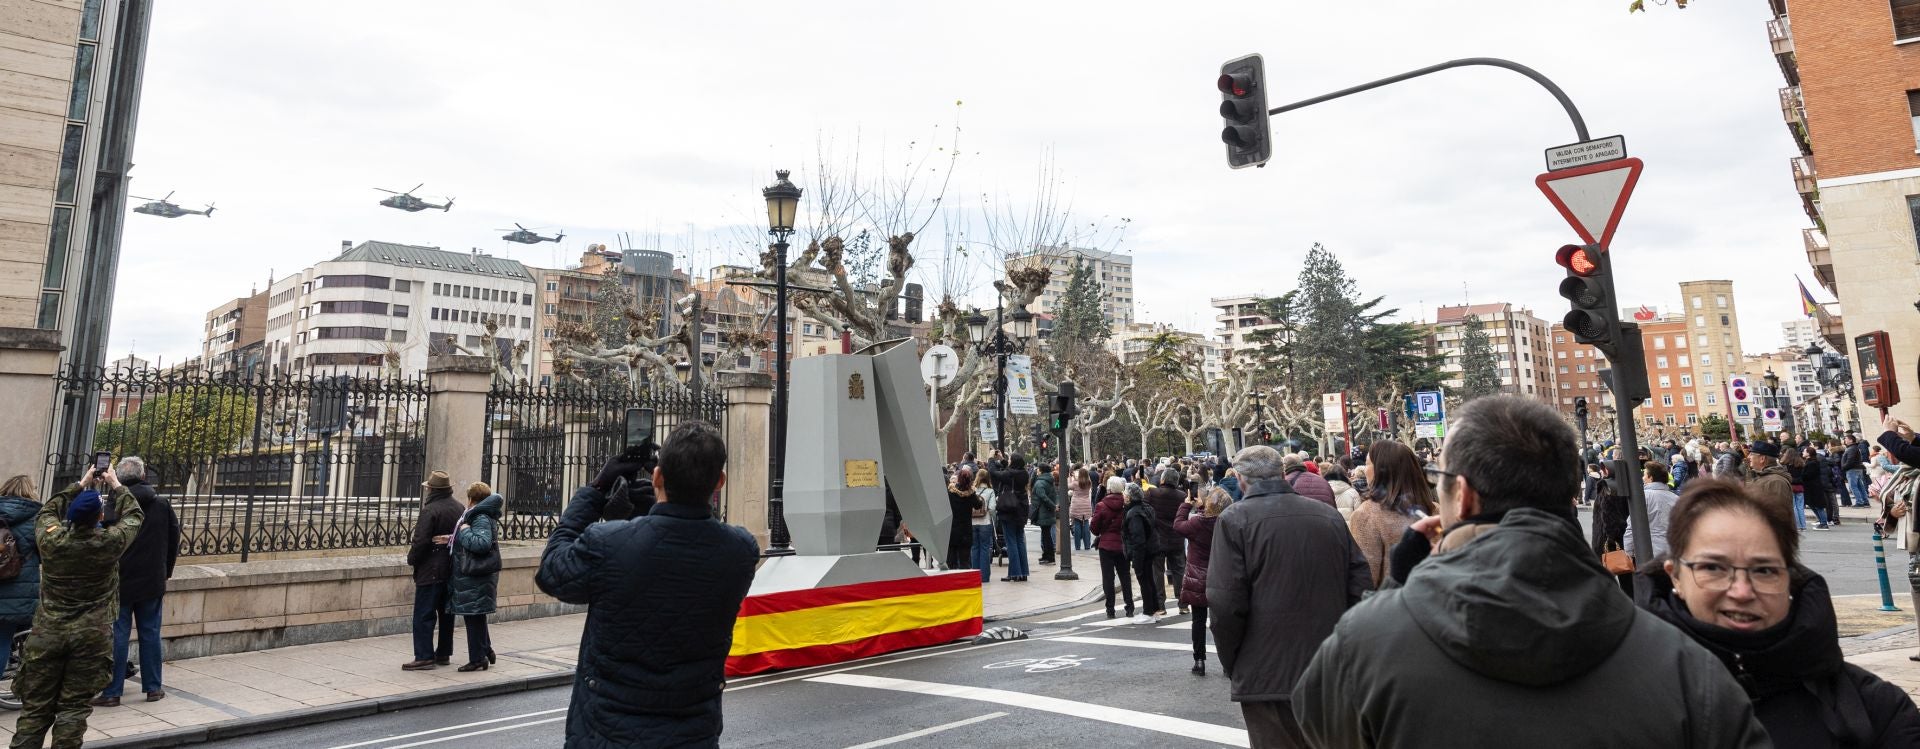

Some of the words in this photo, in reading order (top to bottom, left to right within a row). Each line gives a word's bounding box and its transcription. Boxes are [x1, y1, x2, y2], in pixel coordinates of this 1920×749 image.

[1555, 149, 1572, 157] VALIDA
[1586, 142, 1612, 151] SEMAFORO
[1552, 154, 1588, 166] INTERMITENTE
[1595, 149, 1619, 158] APAGADO
[1421, 396, 1433, 411] P
